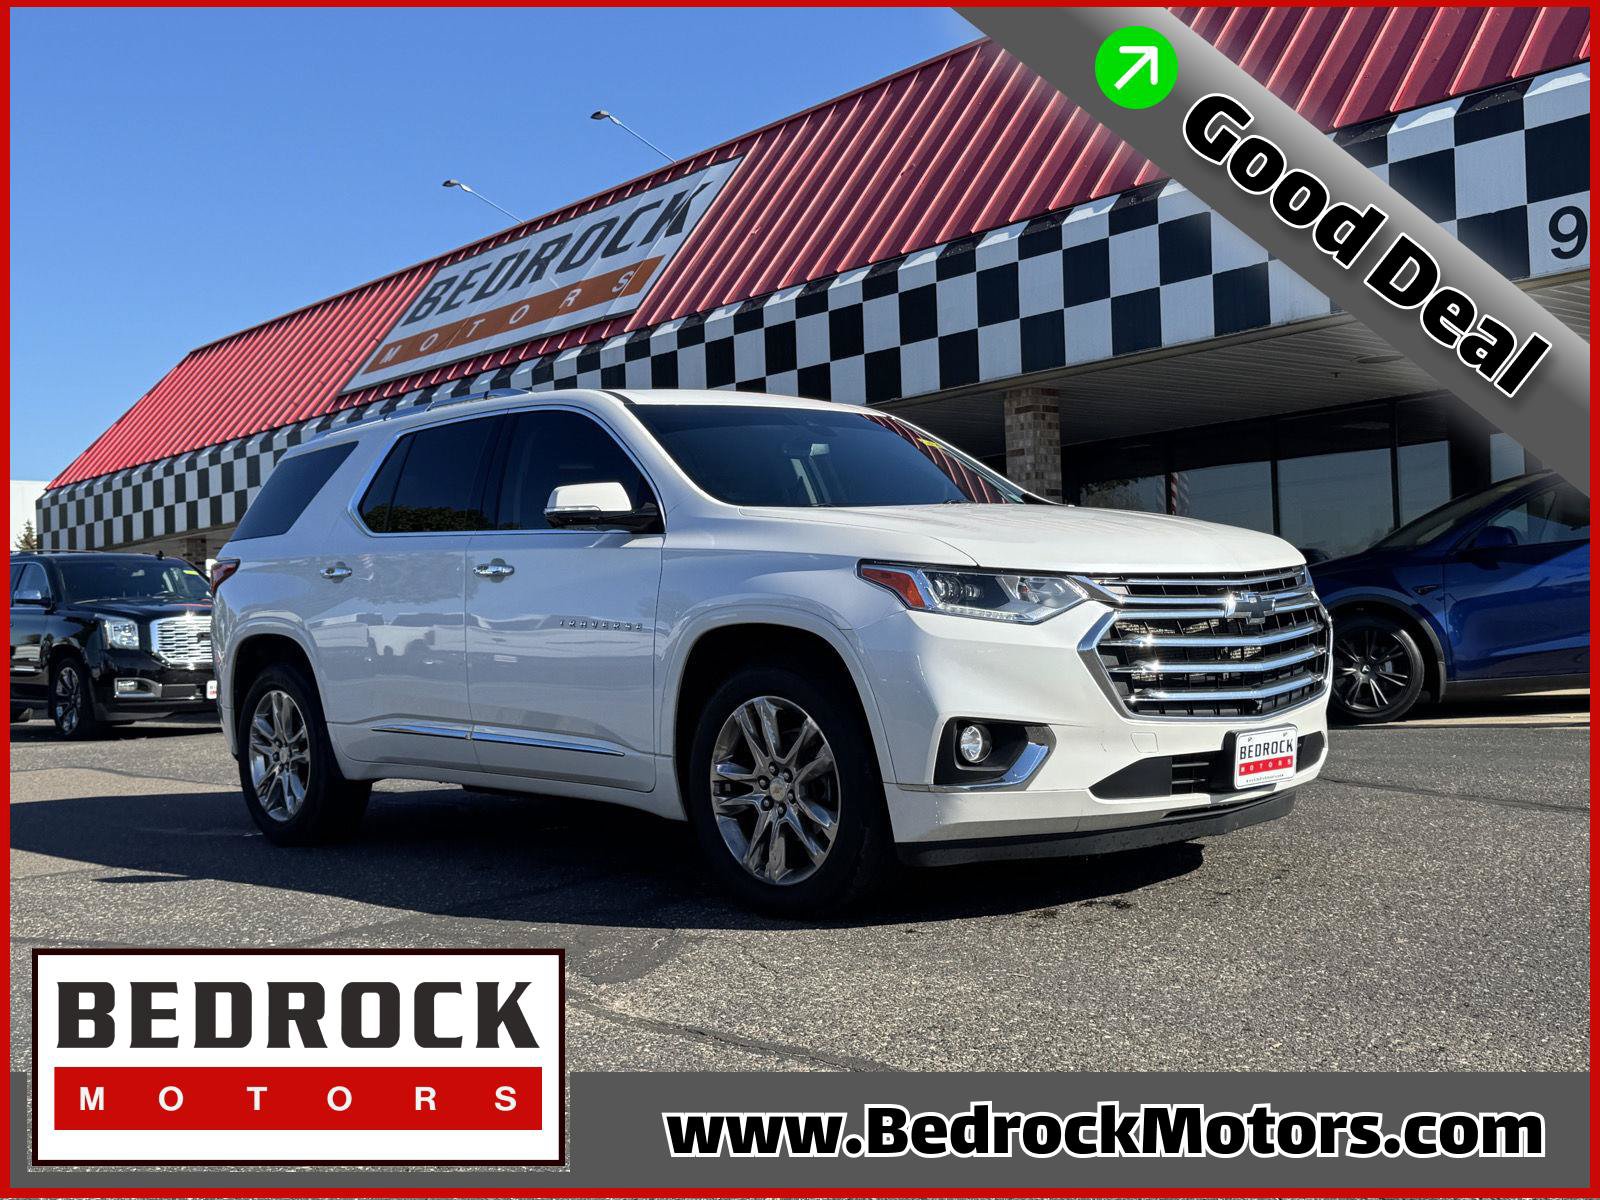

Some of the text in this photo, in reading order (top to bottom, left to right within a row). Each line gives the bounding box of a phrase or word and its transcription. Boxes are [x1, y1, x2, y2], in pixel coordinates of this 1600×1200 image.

[401, 181, 713, 326] BEDROCK
[379, 270, 635, 365] MOTORS
[559, 619, 642, 632] TRAVERSE
[1240, 739, 1293, 760] BEDROCK
[1240, 758, 1291, 773] MOTORS
